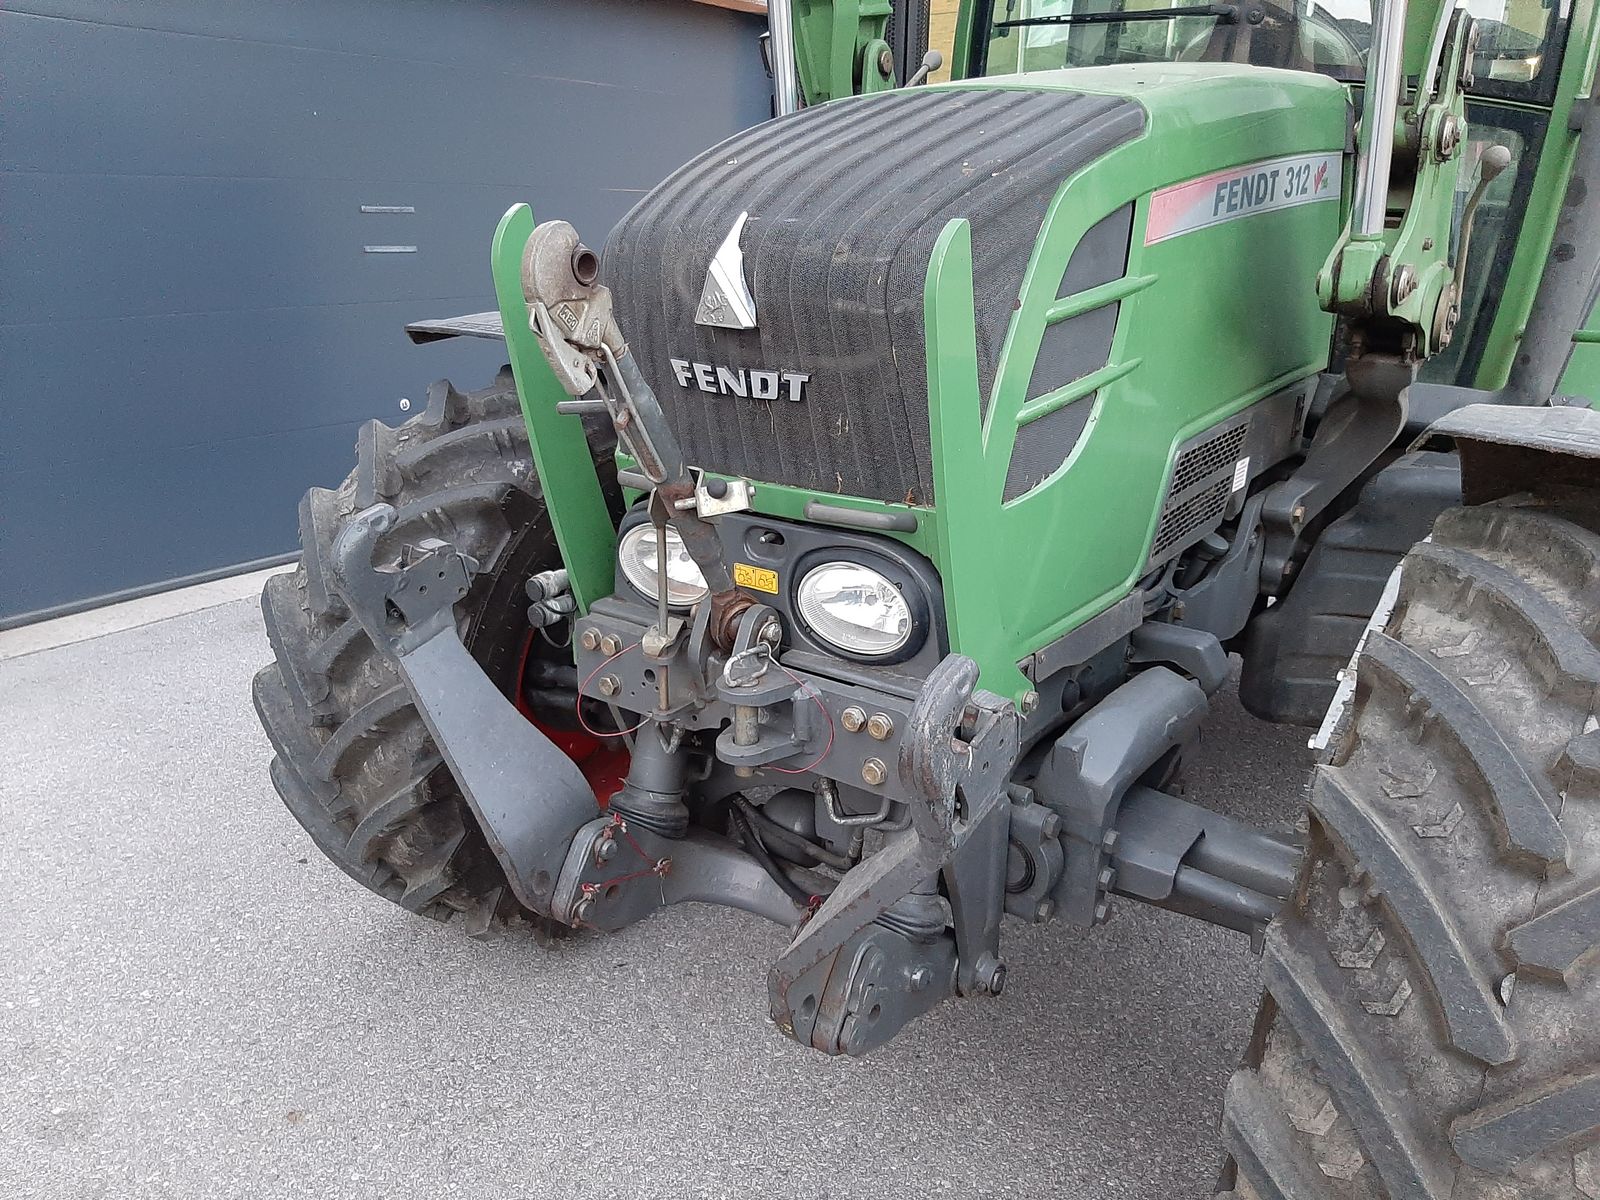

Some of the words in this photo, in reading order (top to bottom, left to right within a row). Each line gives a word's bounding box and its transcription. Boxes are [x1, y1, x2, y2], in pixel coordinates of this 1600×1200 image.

[1212, 169, 1280, 217] FENDT
[1283, 163, 1311, 199] 312
[670, 358, 810, 402] FENDT
